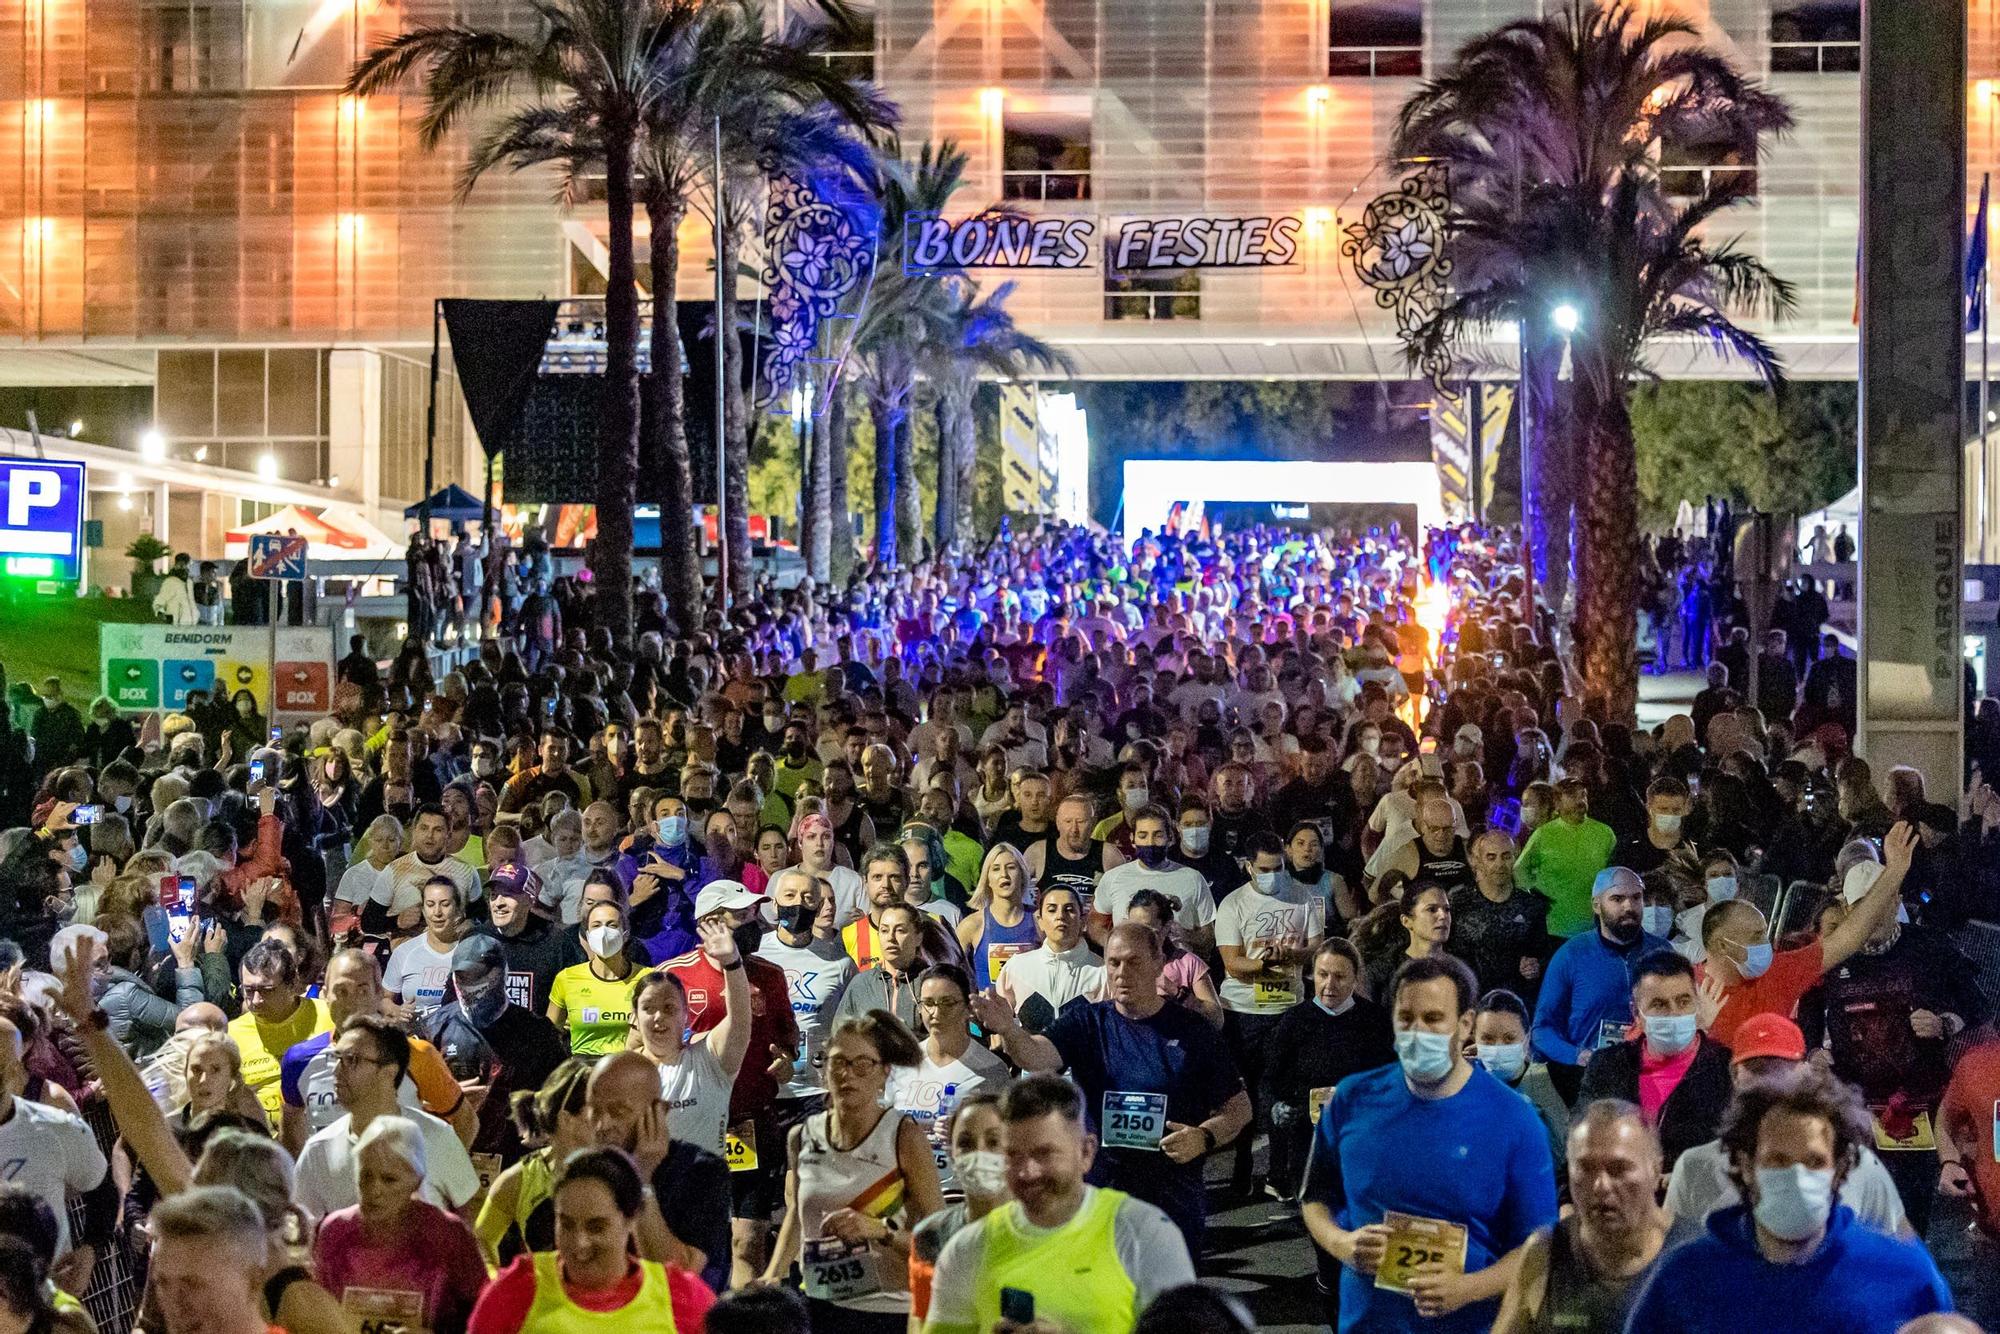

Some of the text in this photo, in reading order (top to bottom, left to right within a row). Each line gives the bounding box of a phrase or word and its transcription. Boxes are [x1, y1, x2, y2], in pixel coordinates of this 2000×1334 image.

[912, 217, 1303, 269] BONES FESTES
[8, 469, 61, 526] P
[1934, 519, 1953, 680] PARQUE
[165, 633, 232, 644] BENIDORM
[119, 688, 147, 700] BOX
[287, 692, 316, 703] BOX
[1262, 982, 1290, 992] 1092
[1111, 1113, 1155, 1132] 2150
[814, 1260, 865, 1285] 2613
